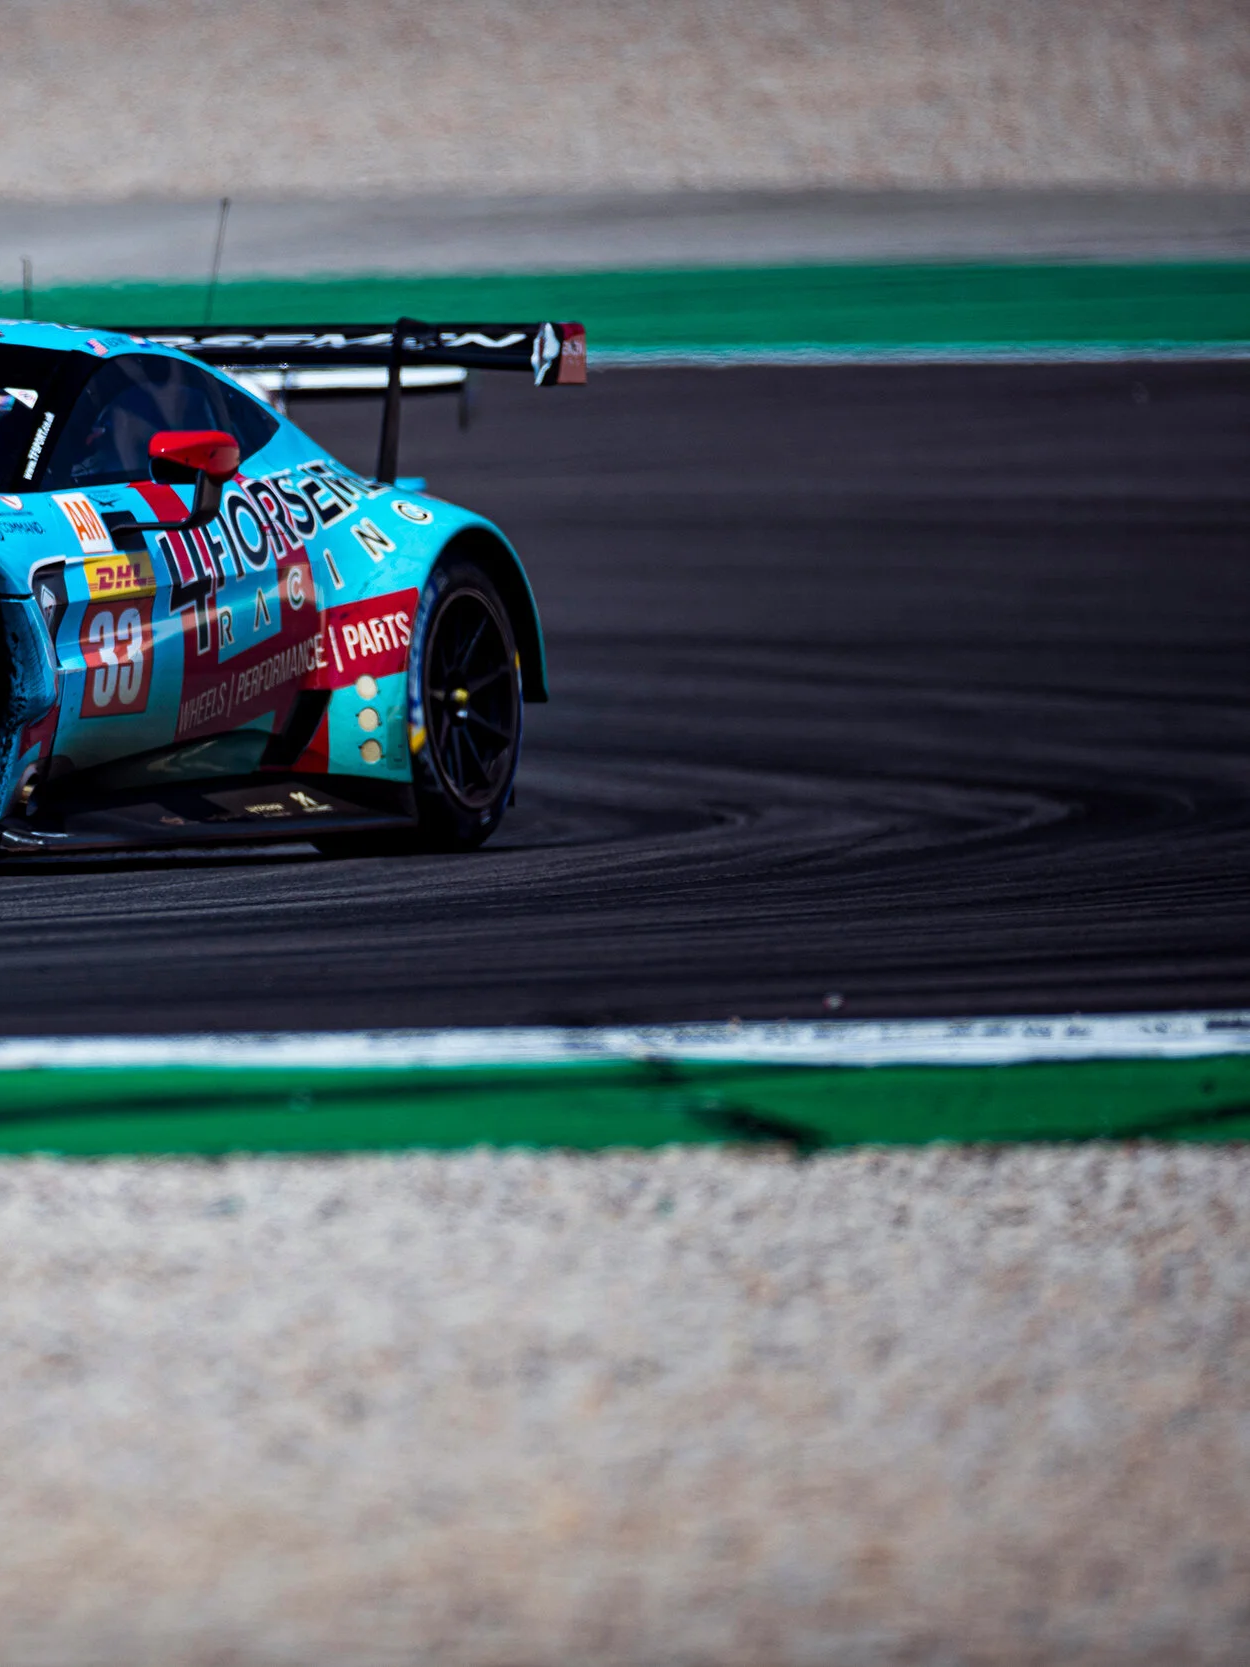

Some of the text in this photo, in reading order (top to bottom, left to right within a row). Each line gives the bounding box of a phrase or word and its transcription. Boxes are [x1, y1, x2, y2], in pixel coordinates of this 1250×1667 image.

[63, 500, 107, 541] AM
[95, 563, 147, 591] DHL
[88, 607, 144, 707] 33
[177, 681, 227, 733] WHEELS
[235, 633, 329, 706] PERFORMANCE
[341, 611, 413, 661] PARTS
